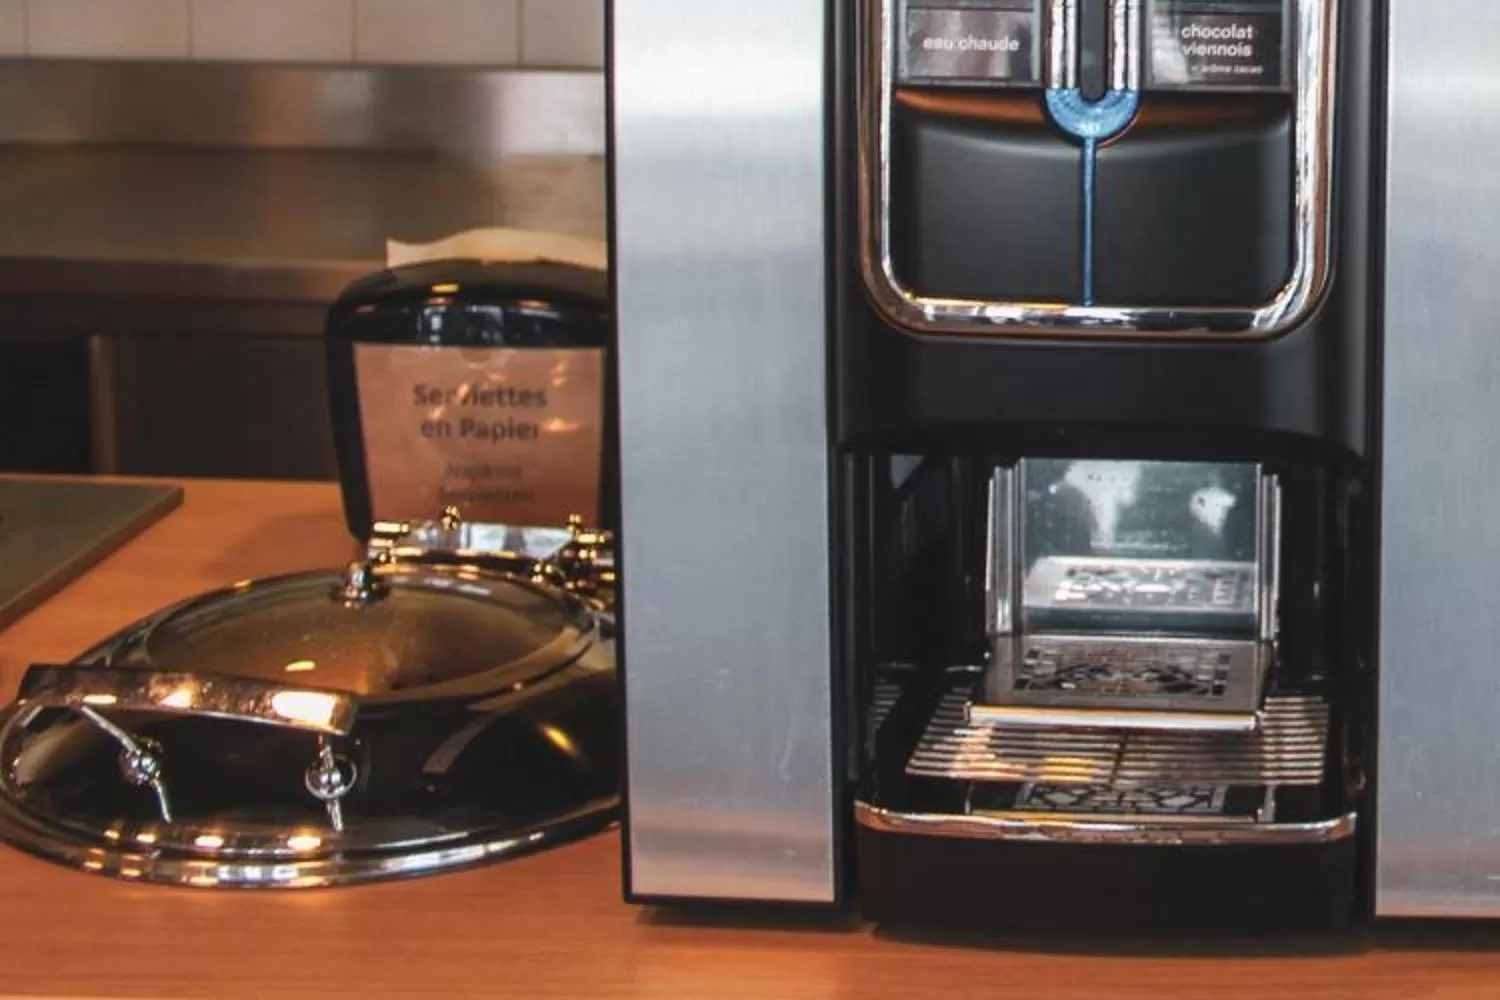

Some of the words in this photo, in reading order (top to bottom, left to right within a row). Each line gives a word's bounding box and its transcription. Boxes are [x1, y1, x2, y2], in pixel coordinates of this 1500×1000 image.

[1181, 23, 1255, 39] chocolat
[923, 37, 953, 50] eau
[958, 34, 1020, 51] chaude
[1182, 41, 1253, 57] viennois
[420, 418, 451, 439] en
[459, 415, 540, 444] Papier
